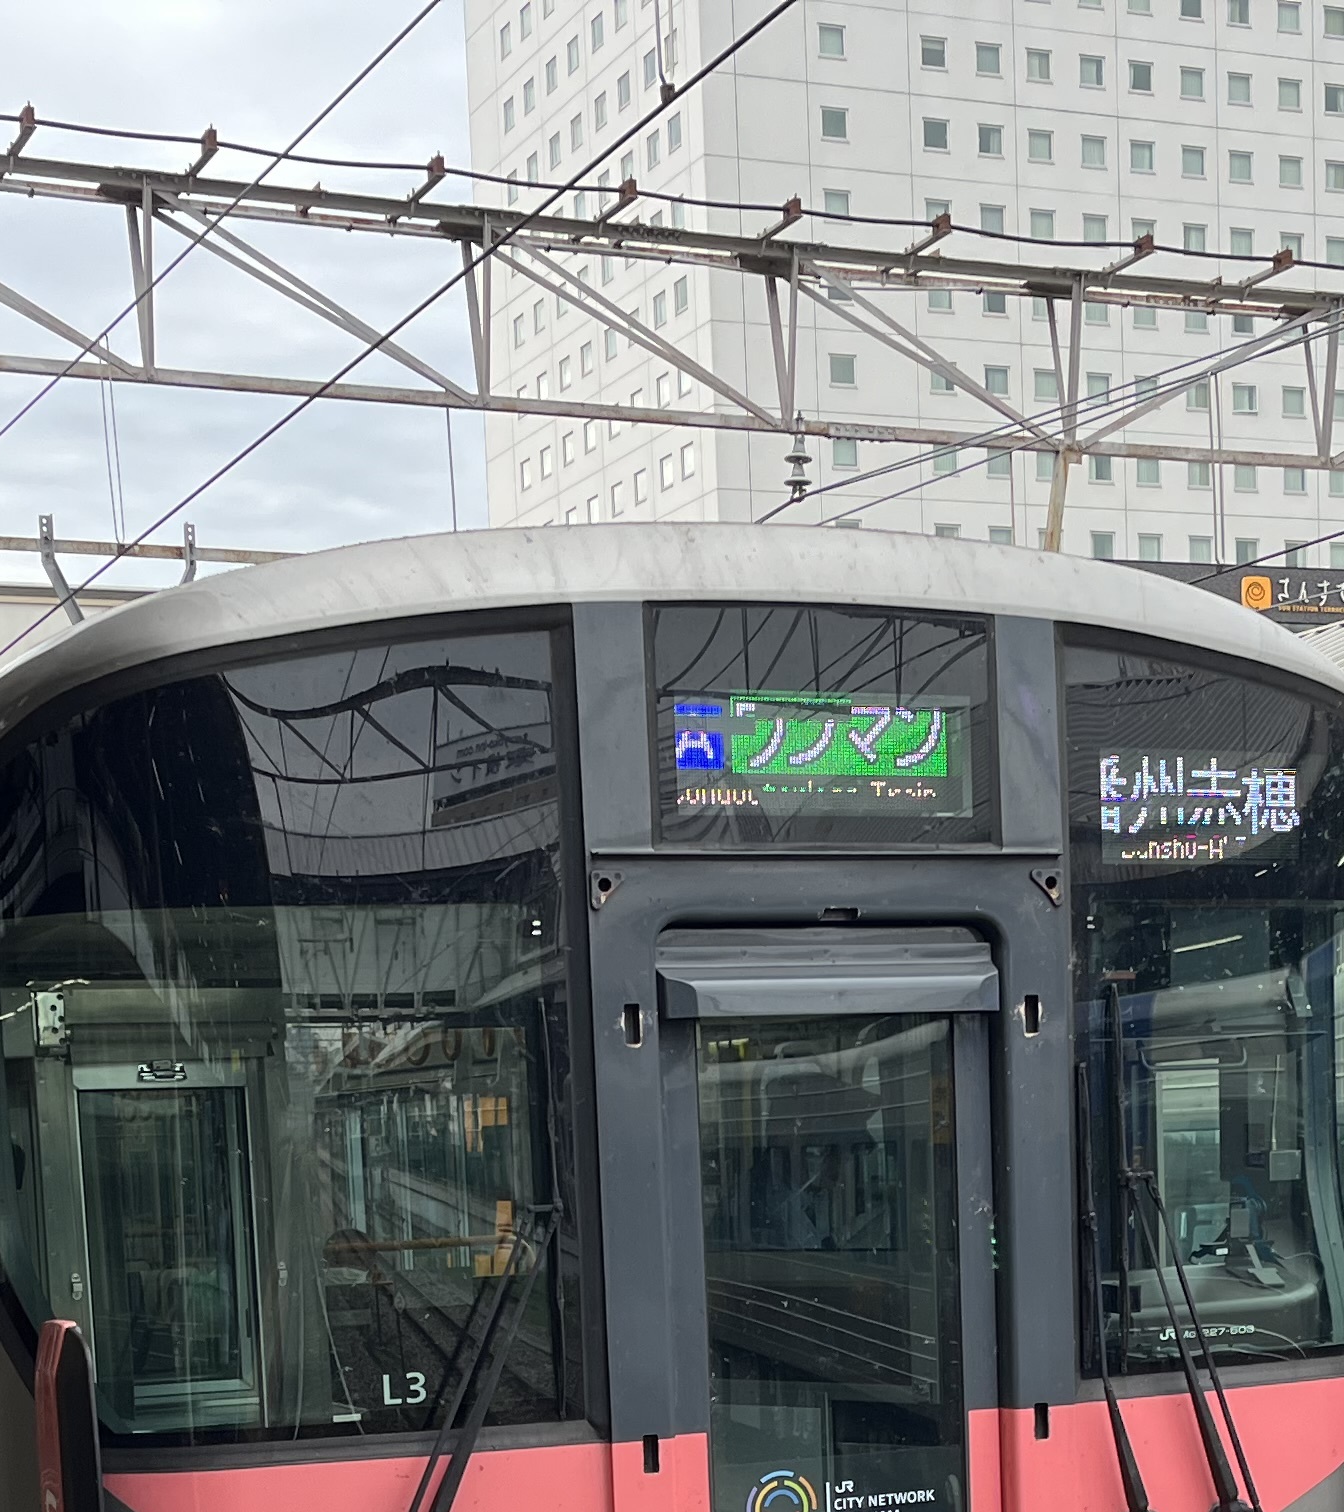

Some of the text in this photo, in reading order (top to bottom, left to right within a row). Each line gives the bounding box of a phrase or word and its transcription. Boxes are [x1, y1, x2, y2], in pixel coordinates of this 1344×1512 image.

[382, 1371, 427, 1406] L3
[835, 1480, 855, 1494] JR
[834, 1488, 936, 1511] CITY NETWORK
